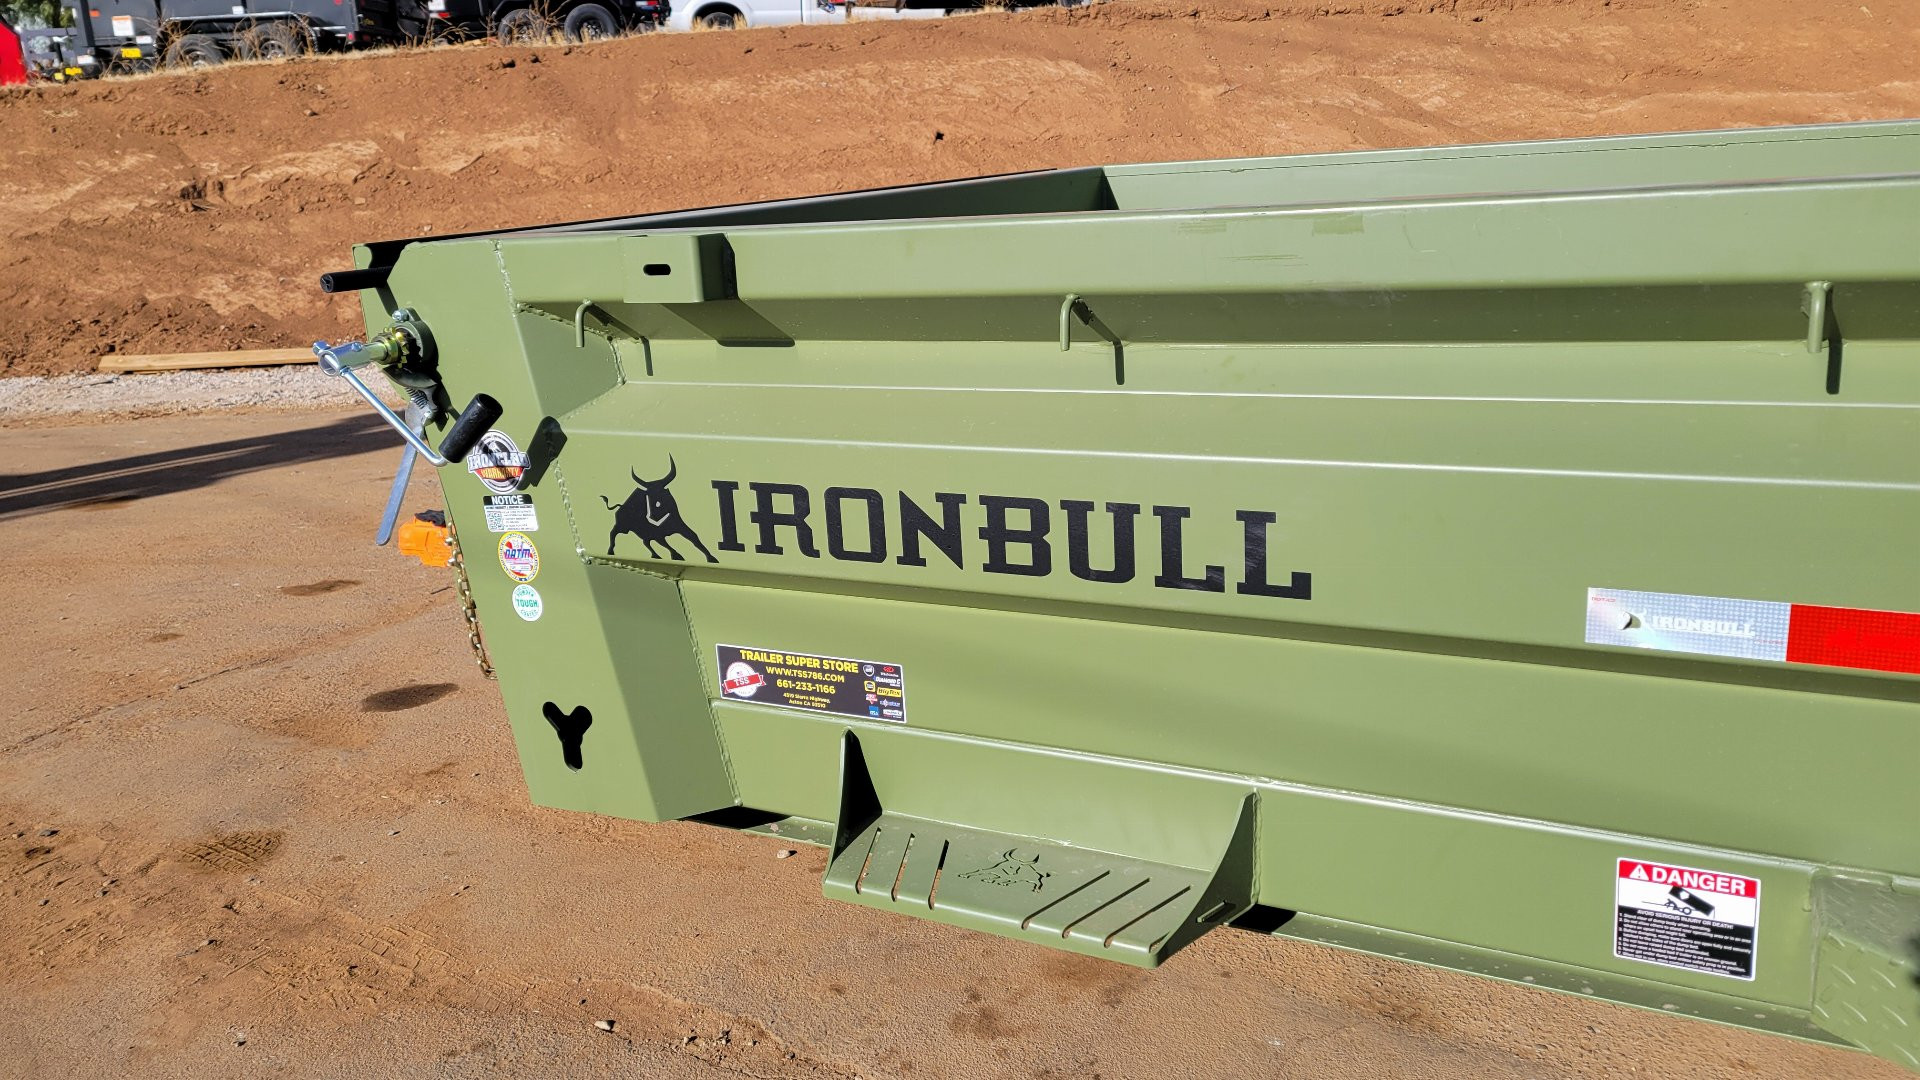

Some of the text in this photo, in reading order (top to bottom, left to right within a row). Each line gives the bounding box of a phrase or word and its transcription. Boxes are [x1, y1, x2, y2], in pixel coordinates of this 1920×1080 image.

[491, 495, 524, 505] NOTICE
[710, 479, 1312, 600] IRONBULL
[516, 599, 538, 608] TOUGH
[1651, 614, 1756, 638] IRONBULL
[740, 649, 783, 665] TRAILER
[785, 655, 820, 669] SUPER
[822, 659, 859, 673] STORE
[733, 676, 750, 686] TSS
[765, 665, 845, 683] WWW.TSS786.COM
[776, 679, 836, 694] 661-233-1166
[1651, 866, 1746, 896] DANGER
